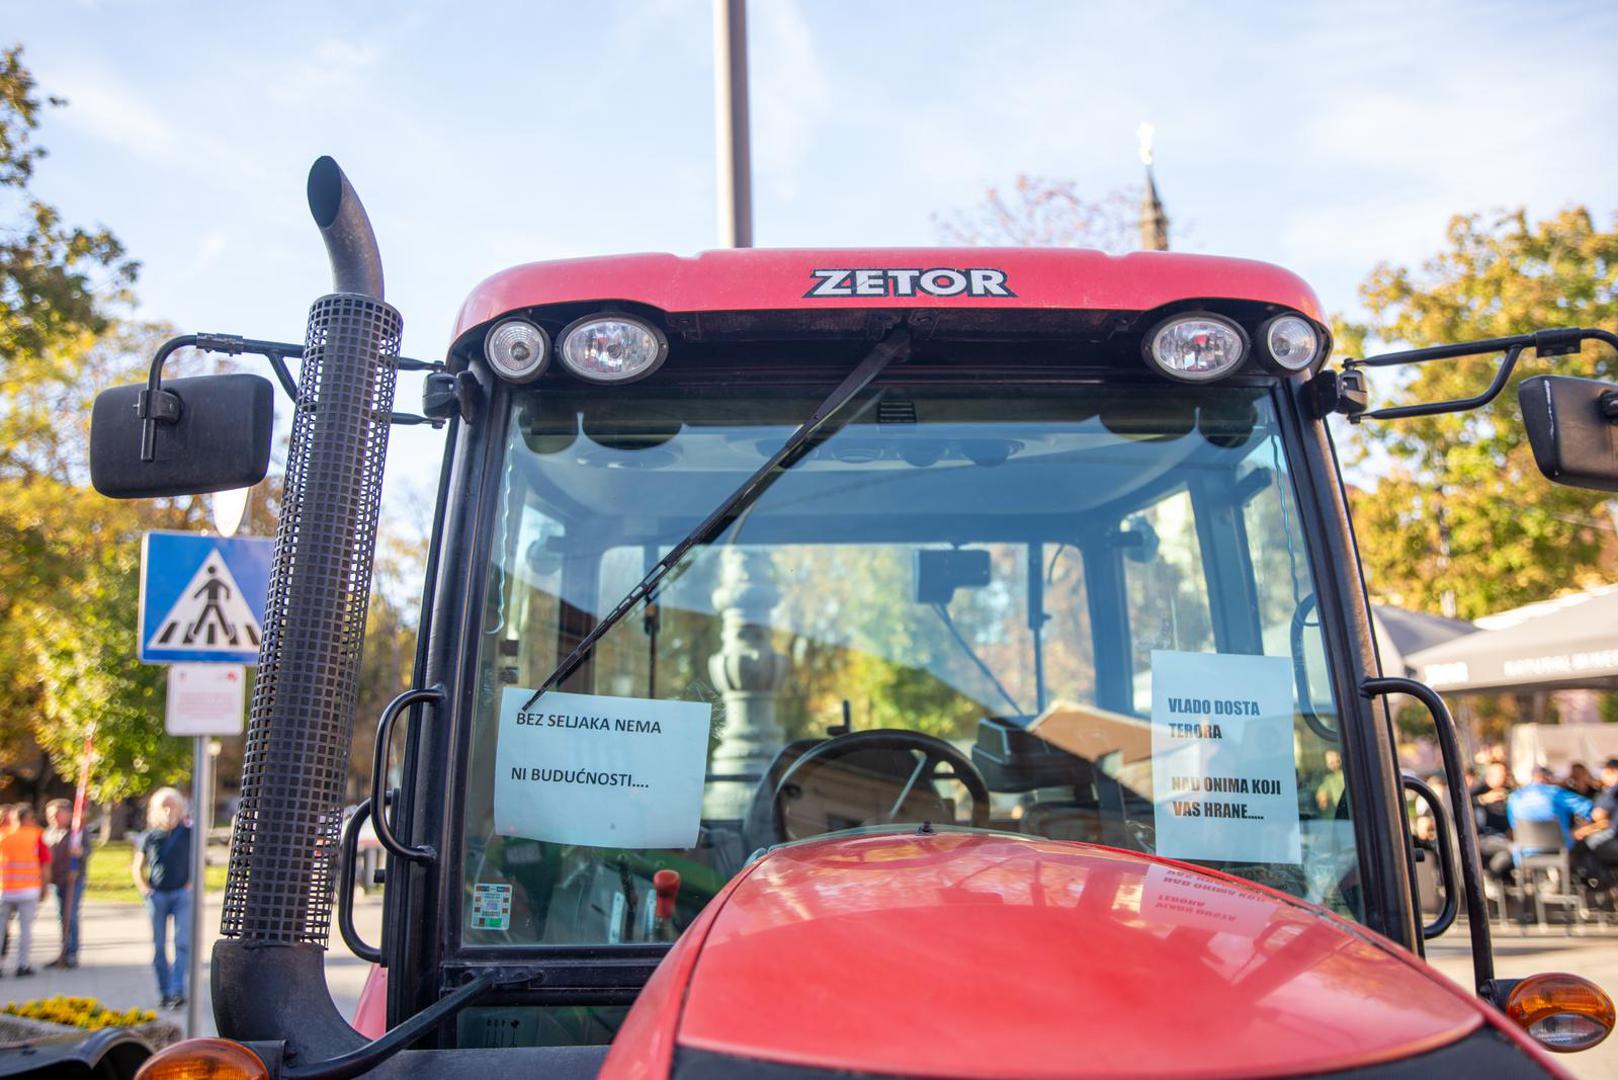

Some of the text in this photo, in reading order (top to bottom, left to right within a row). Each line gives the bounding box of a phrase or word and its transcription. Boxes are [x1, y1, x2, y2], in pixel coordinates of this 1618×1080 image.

[802, 267, 1018, 297] ZETOR
[1168, 698, 1260, 716] VLADO DOSTA
[516, 712, 662, 734] BEZ SELJAKA NEMA
[1168, 723, 1222, 739] TERORA
[511, 767, 649, 788] NI BUDUĆNOSTI....
[1204, 777, 1249, 794] ONIMA
[1252, 779, 1281, 795] KOJI
[1173, 801, 1201, 817] VAS
